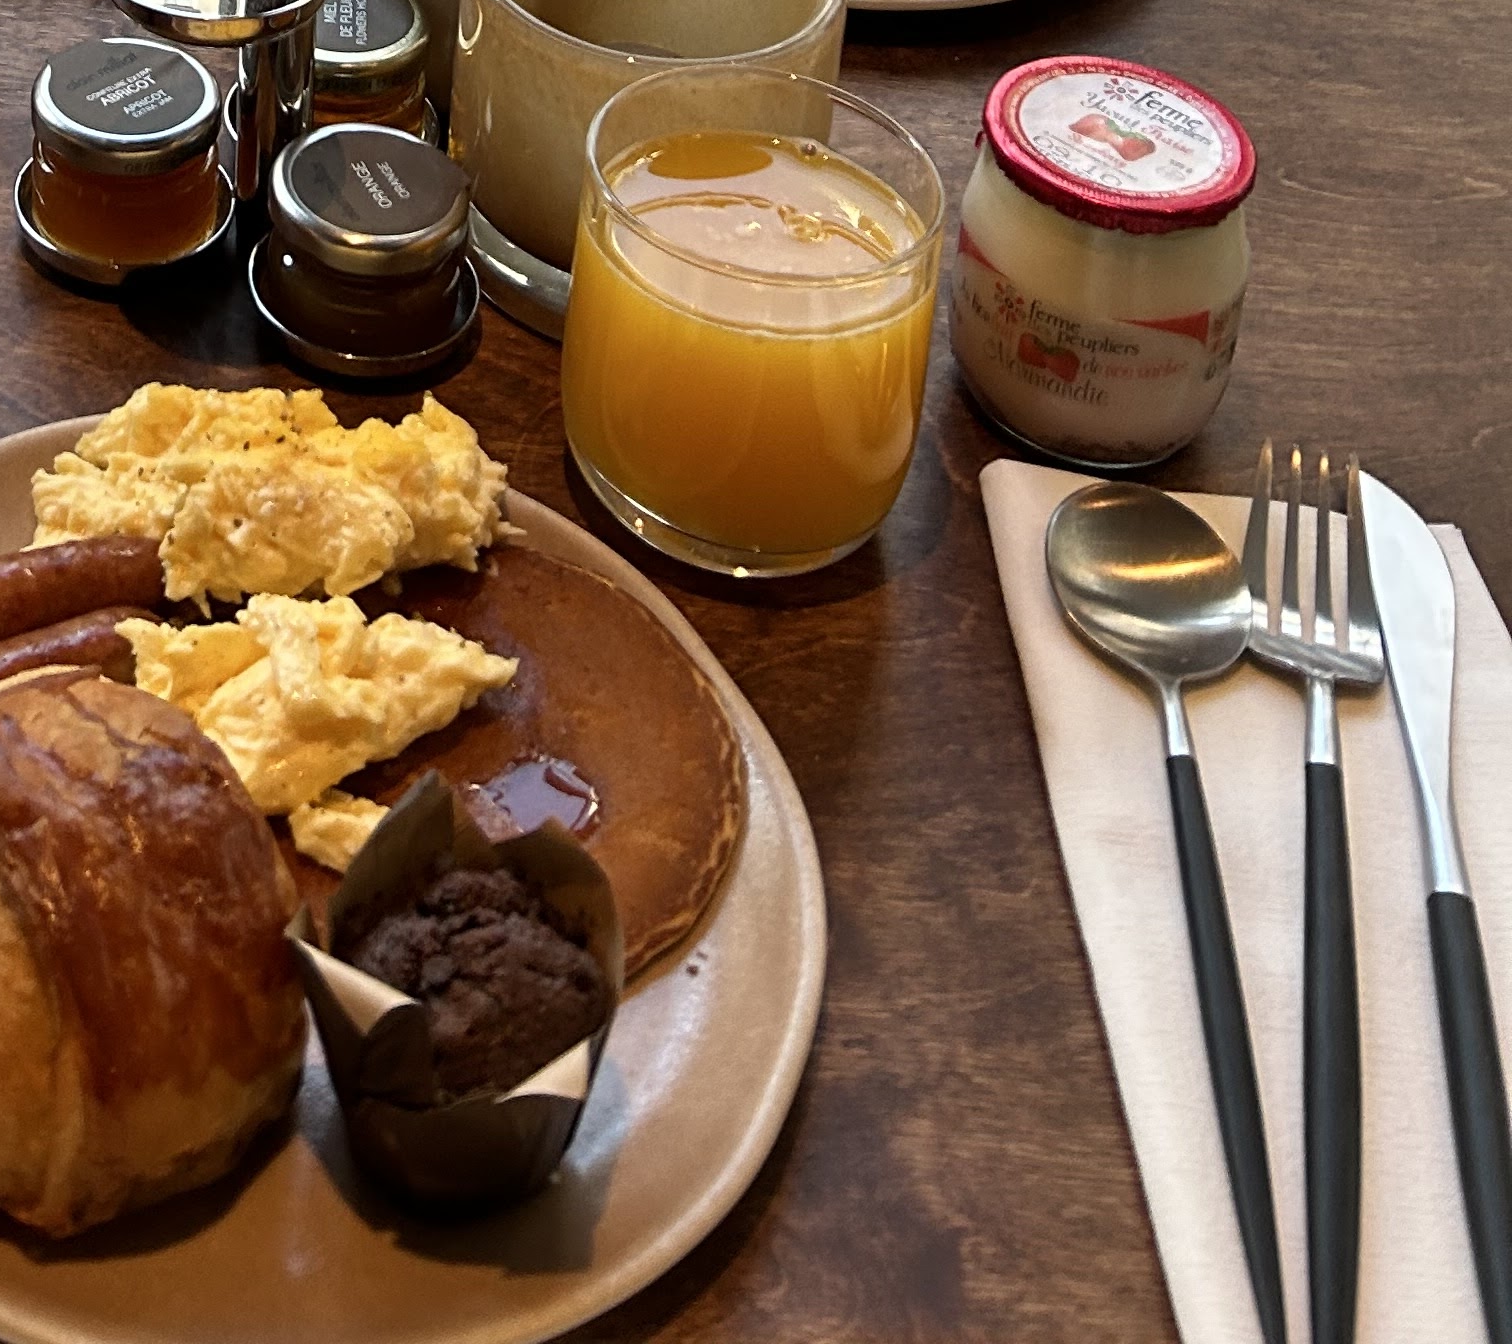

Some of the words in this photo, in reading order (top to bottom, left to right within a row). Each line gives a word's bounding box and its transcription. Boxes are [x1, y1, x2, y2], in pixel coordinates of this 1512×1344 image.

[100, 74, 157, 107] ABRICOT
[122, 88, 169, 116] APRICOT
[1135, 90, 1205, 129] ferme
[351, 160, 393, 209] ORANGE
[376, 161, 411, 199] ORANGE
[1028, 299, 1081, 332] ferme
[1057, 329, 1140, 357] peupliers
